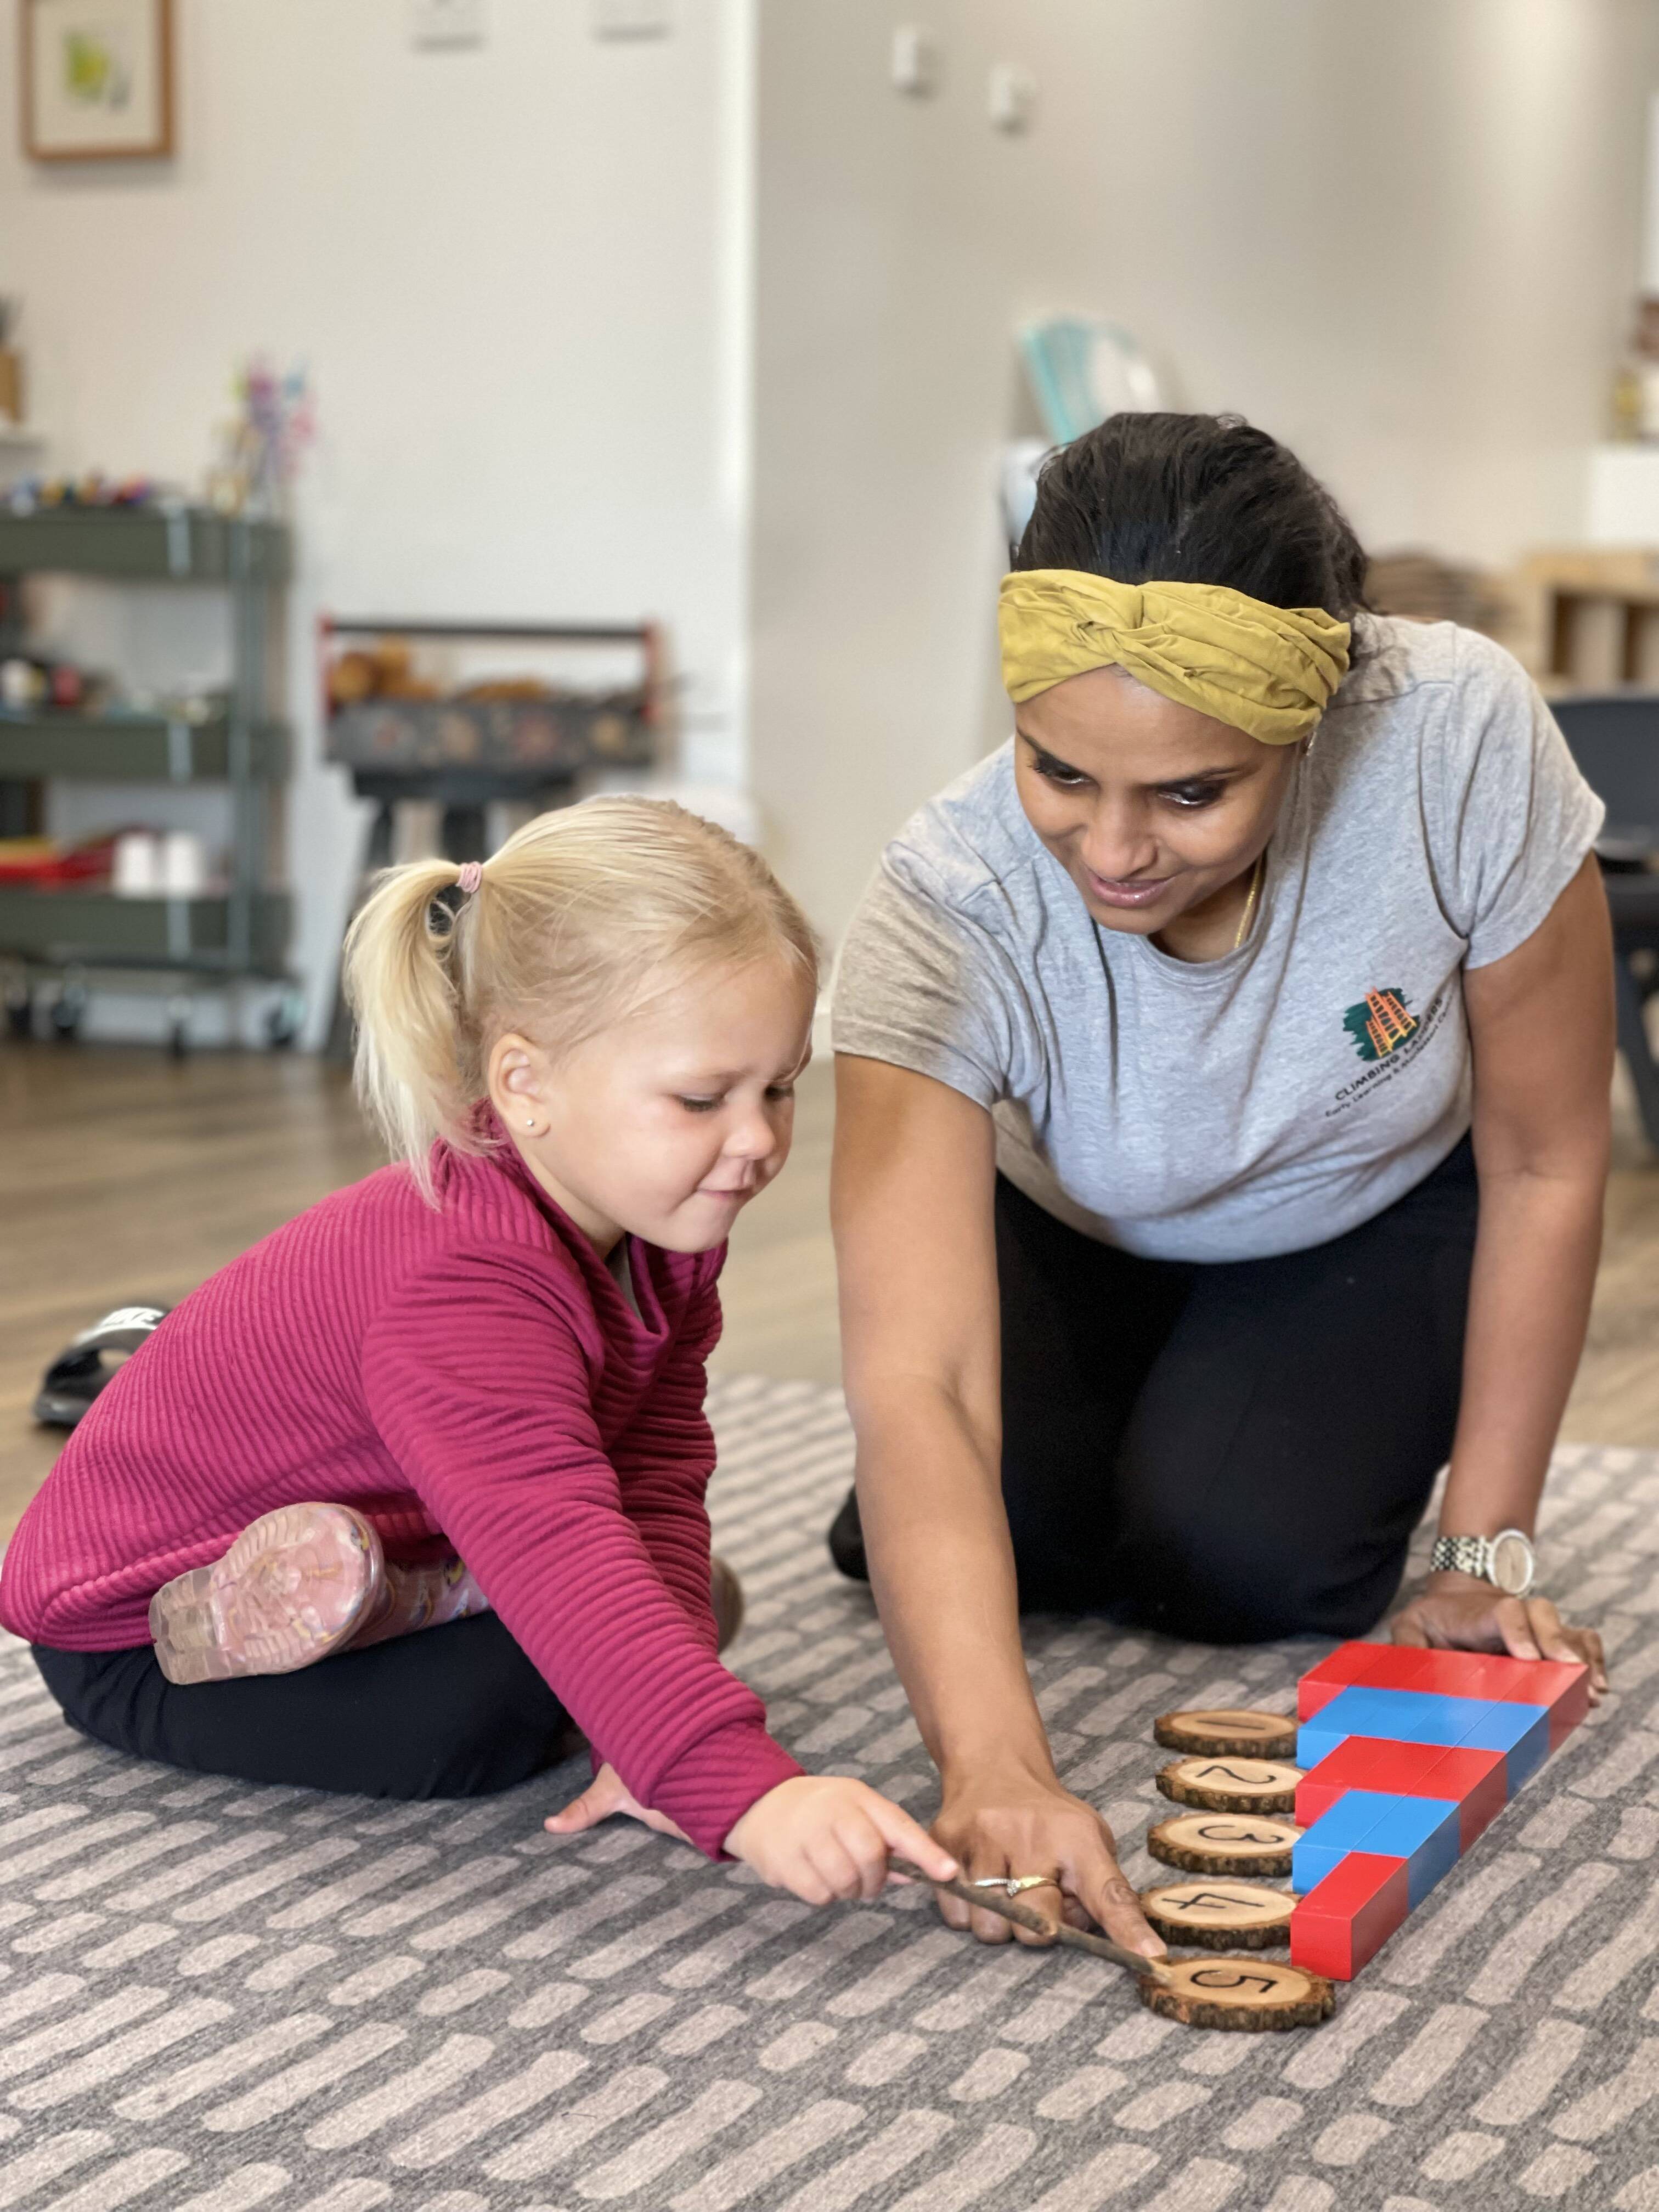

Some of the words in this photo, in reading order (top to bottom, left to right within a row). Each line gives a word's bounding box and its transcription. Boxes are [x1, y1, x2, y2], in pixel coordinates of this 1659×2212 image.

[1335, 1054, 1401, 1101] CLIMBING
[1325, 1102, 1351, 1118] Early
[1352, 1074, 1392, 1103] Learning
[1195, 1764, 1277, 1784] 2
[1198, 1824, 1284, 1845] 3
[1162, 1892, 1265, 1910] 4
[1190, 1969, 1278, 1994] 5
